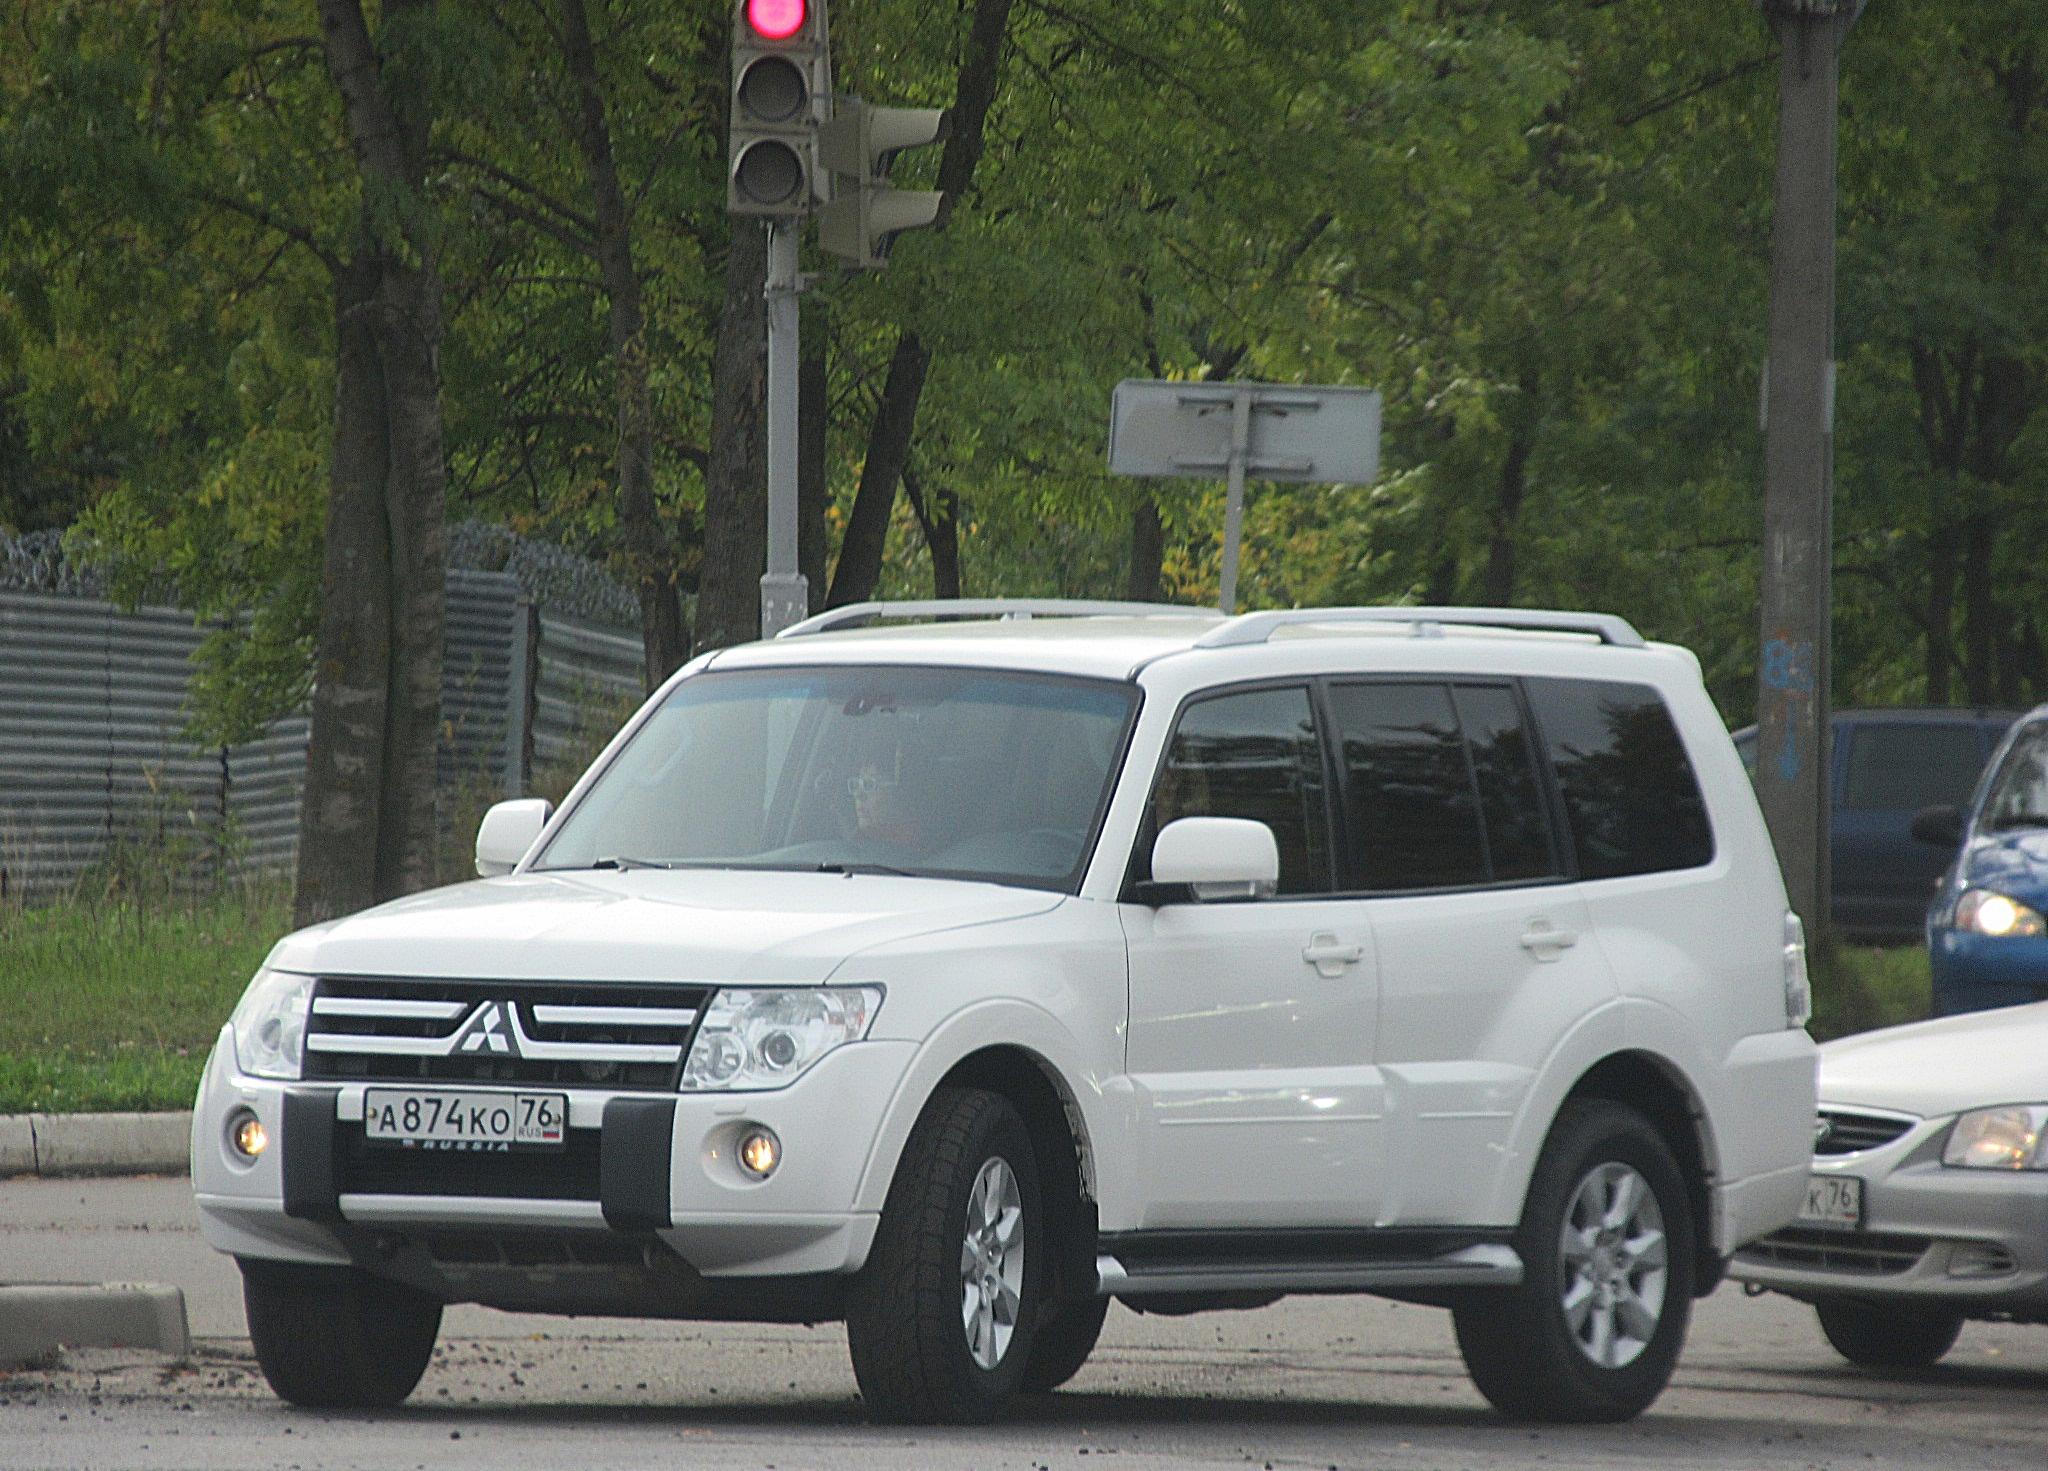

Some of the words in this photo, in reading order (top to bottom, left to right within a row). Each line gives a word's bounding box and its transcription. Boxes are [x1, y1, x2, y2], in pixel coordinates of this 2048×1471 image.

[379, 1097, 510, 1135] A874KO
[521, 1099, 552, 1127] 76
[518, 1126, 542, 1138] RUS
[1829, 1180, 1852, 1208] 76
